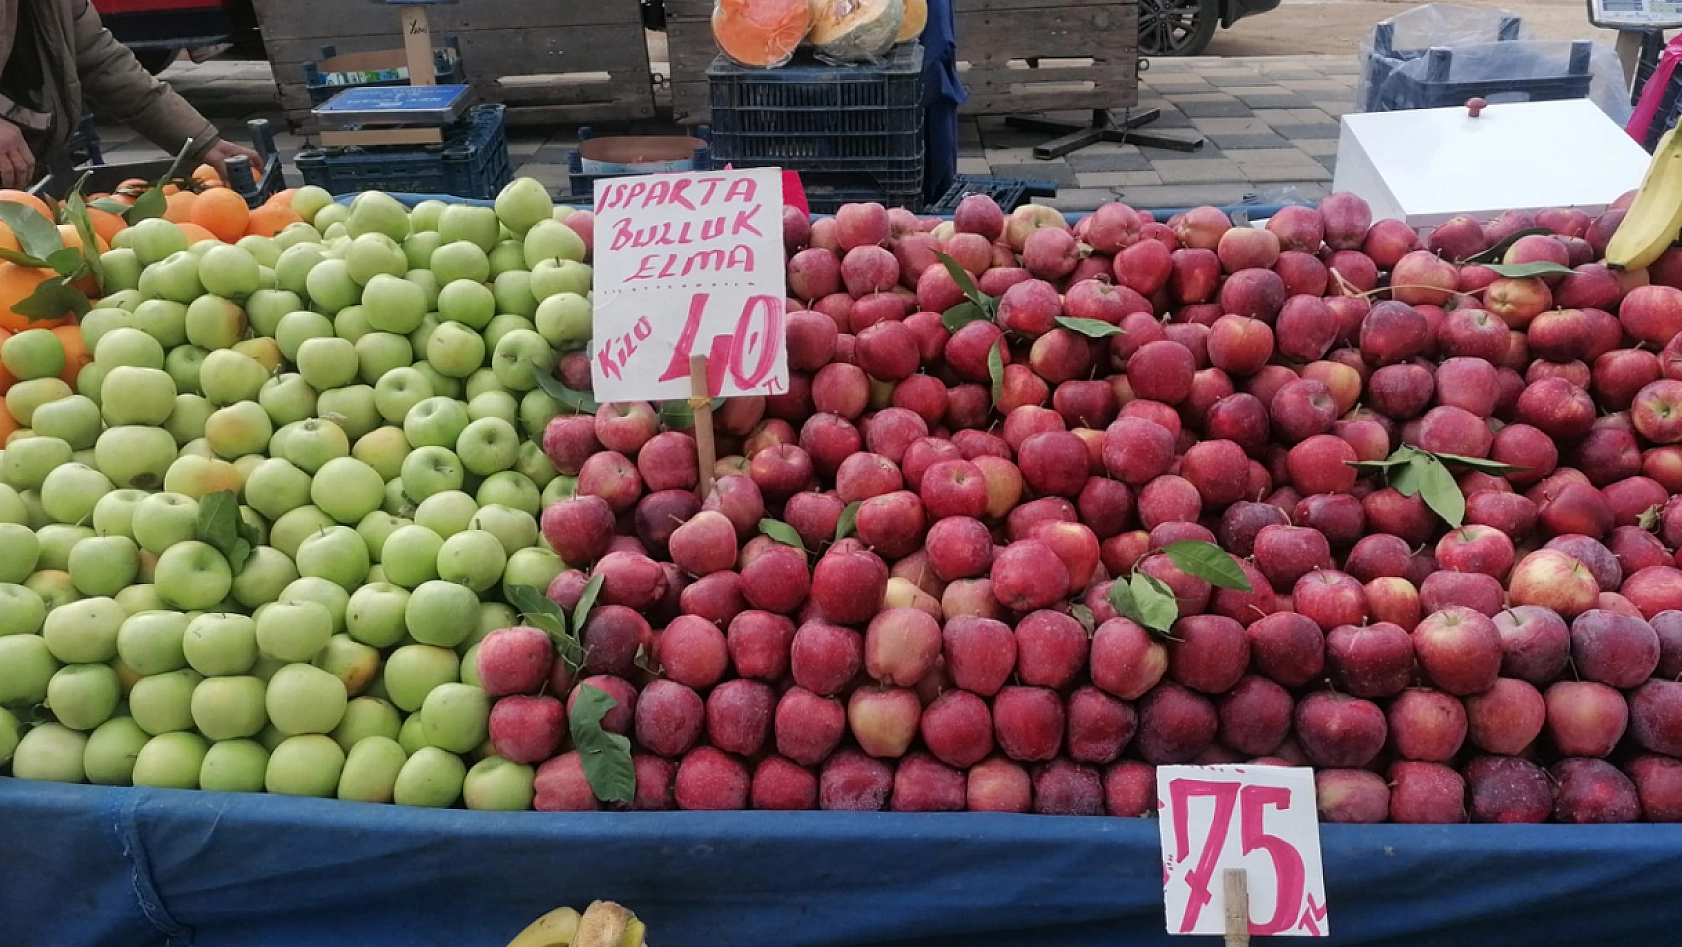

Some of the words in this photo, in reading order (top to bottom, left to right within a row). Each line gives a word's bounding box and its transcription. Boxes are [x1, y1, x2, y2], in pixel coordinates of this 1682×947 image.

[595, 177, 758, 215] ISPARTA
[623, 245, 755, 283] ELMA
[658, 293, 782, 396] 40
[1169, 778, 1306, 936] 75
